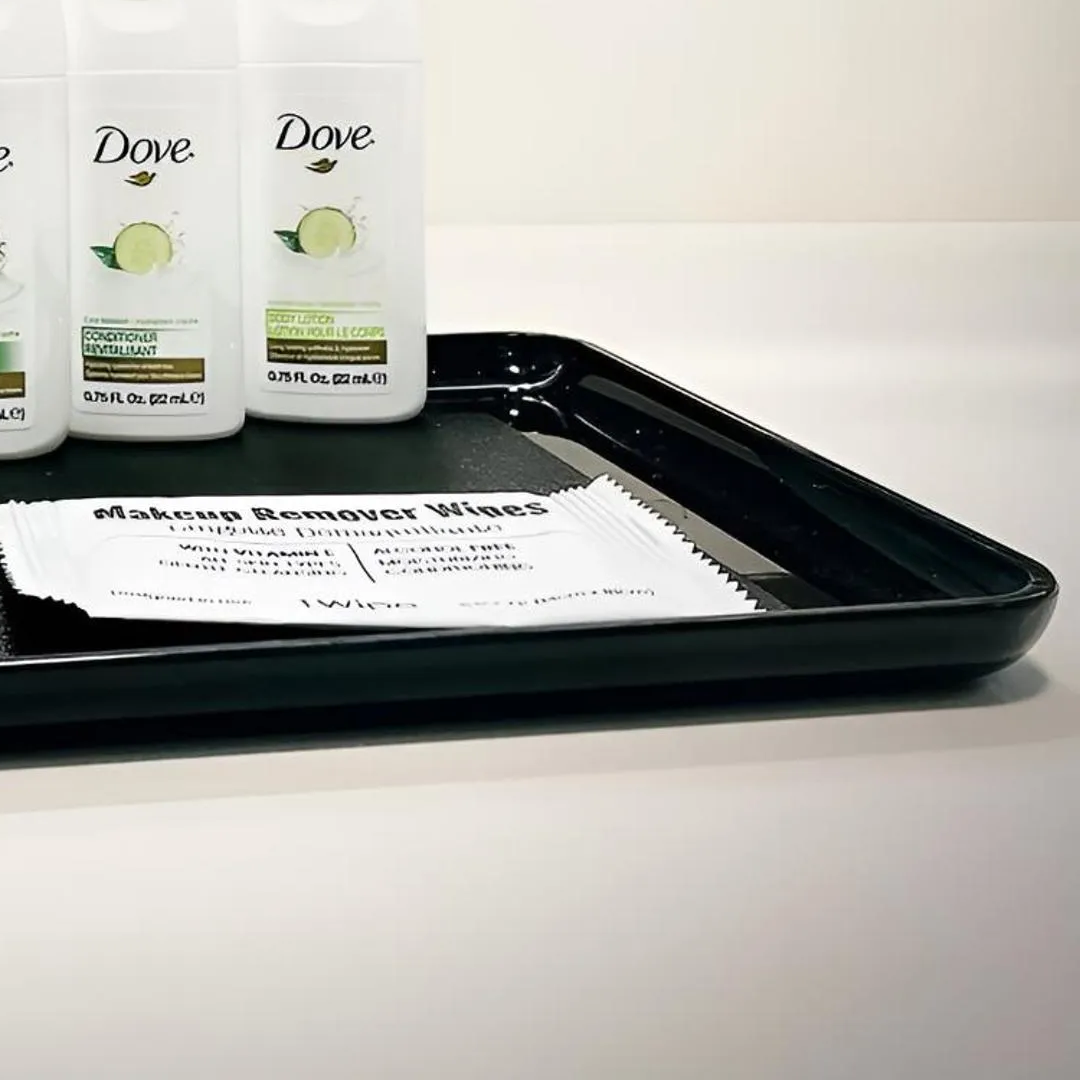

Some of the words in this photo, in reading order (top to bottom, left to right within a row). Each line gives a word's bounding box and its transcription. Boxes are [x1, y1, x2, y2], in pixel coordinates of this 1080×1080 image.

[93, 125, 195, 164] Dove
[276, 113, 375, 151] Dove
[93, 504, 242, 522] Makeup
[251, 506, 418, 522] Remover
[424, 500, 549, 519] Wipes
